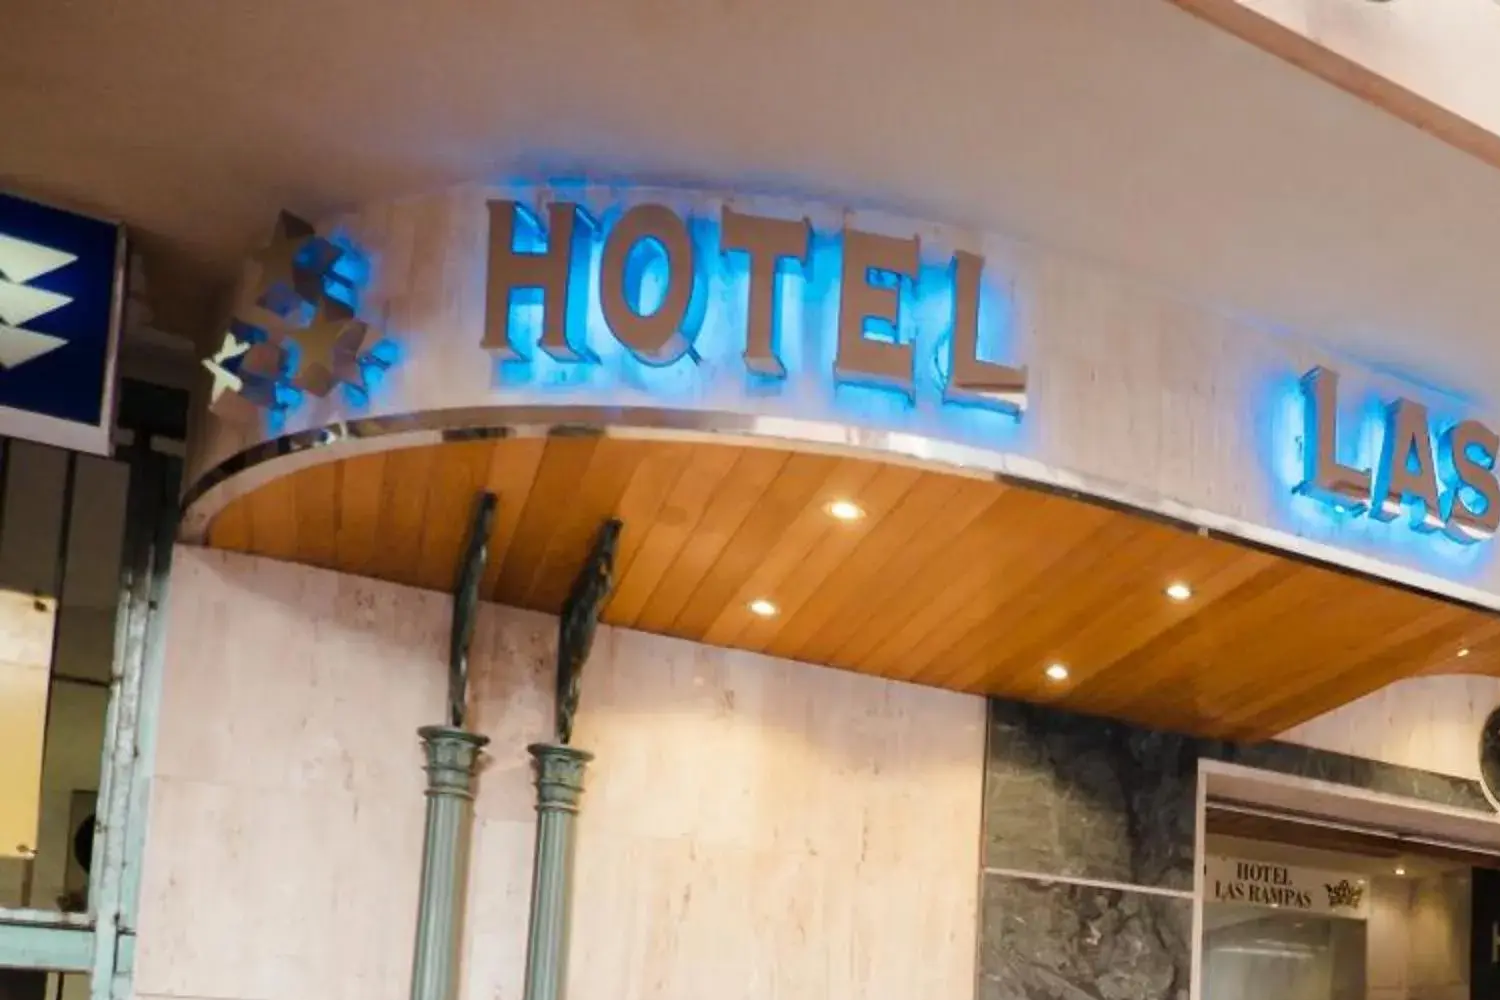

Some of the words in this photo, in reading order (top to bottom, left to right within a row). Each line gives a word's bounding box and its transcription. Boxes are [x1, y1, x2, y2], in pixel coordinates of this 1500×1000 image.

[480, 198, 1028, 418] HOTEL
[1236, 861, 1293, 887] HOTEL
[1215, 879, 1244, 901] LAS
[1249, 884, 1313, 909] RAMPAS
